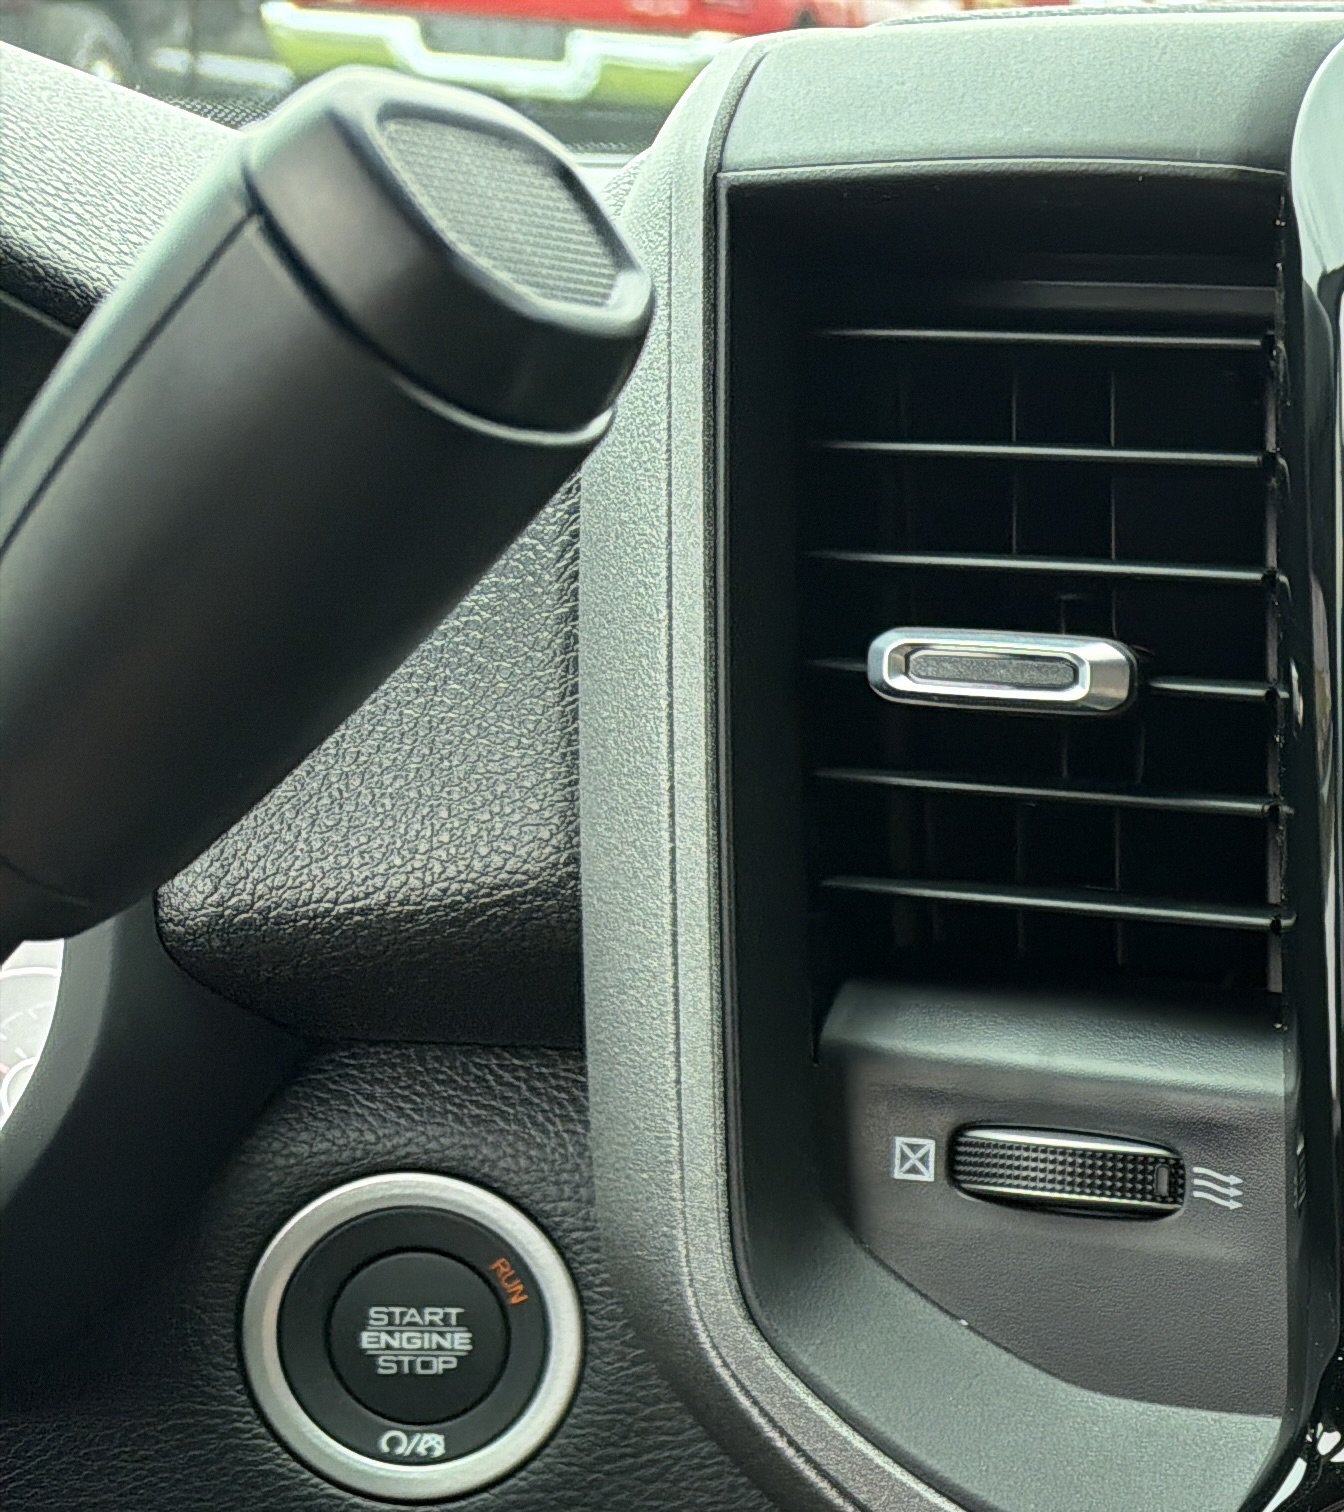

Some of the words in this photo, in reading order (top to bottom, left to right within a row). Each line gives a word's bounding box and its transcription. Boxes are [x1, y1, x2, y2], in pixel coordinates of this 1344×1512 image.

[489, 1257, 529, 1305] RUN
[367, 1306, 465, 1327] START
[359, 1331, 474, 1350] ENGINE
[376, 1355, 459, 1375] STOP
